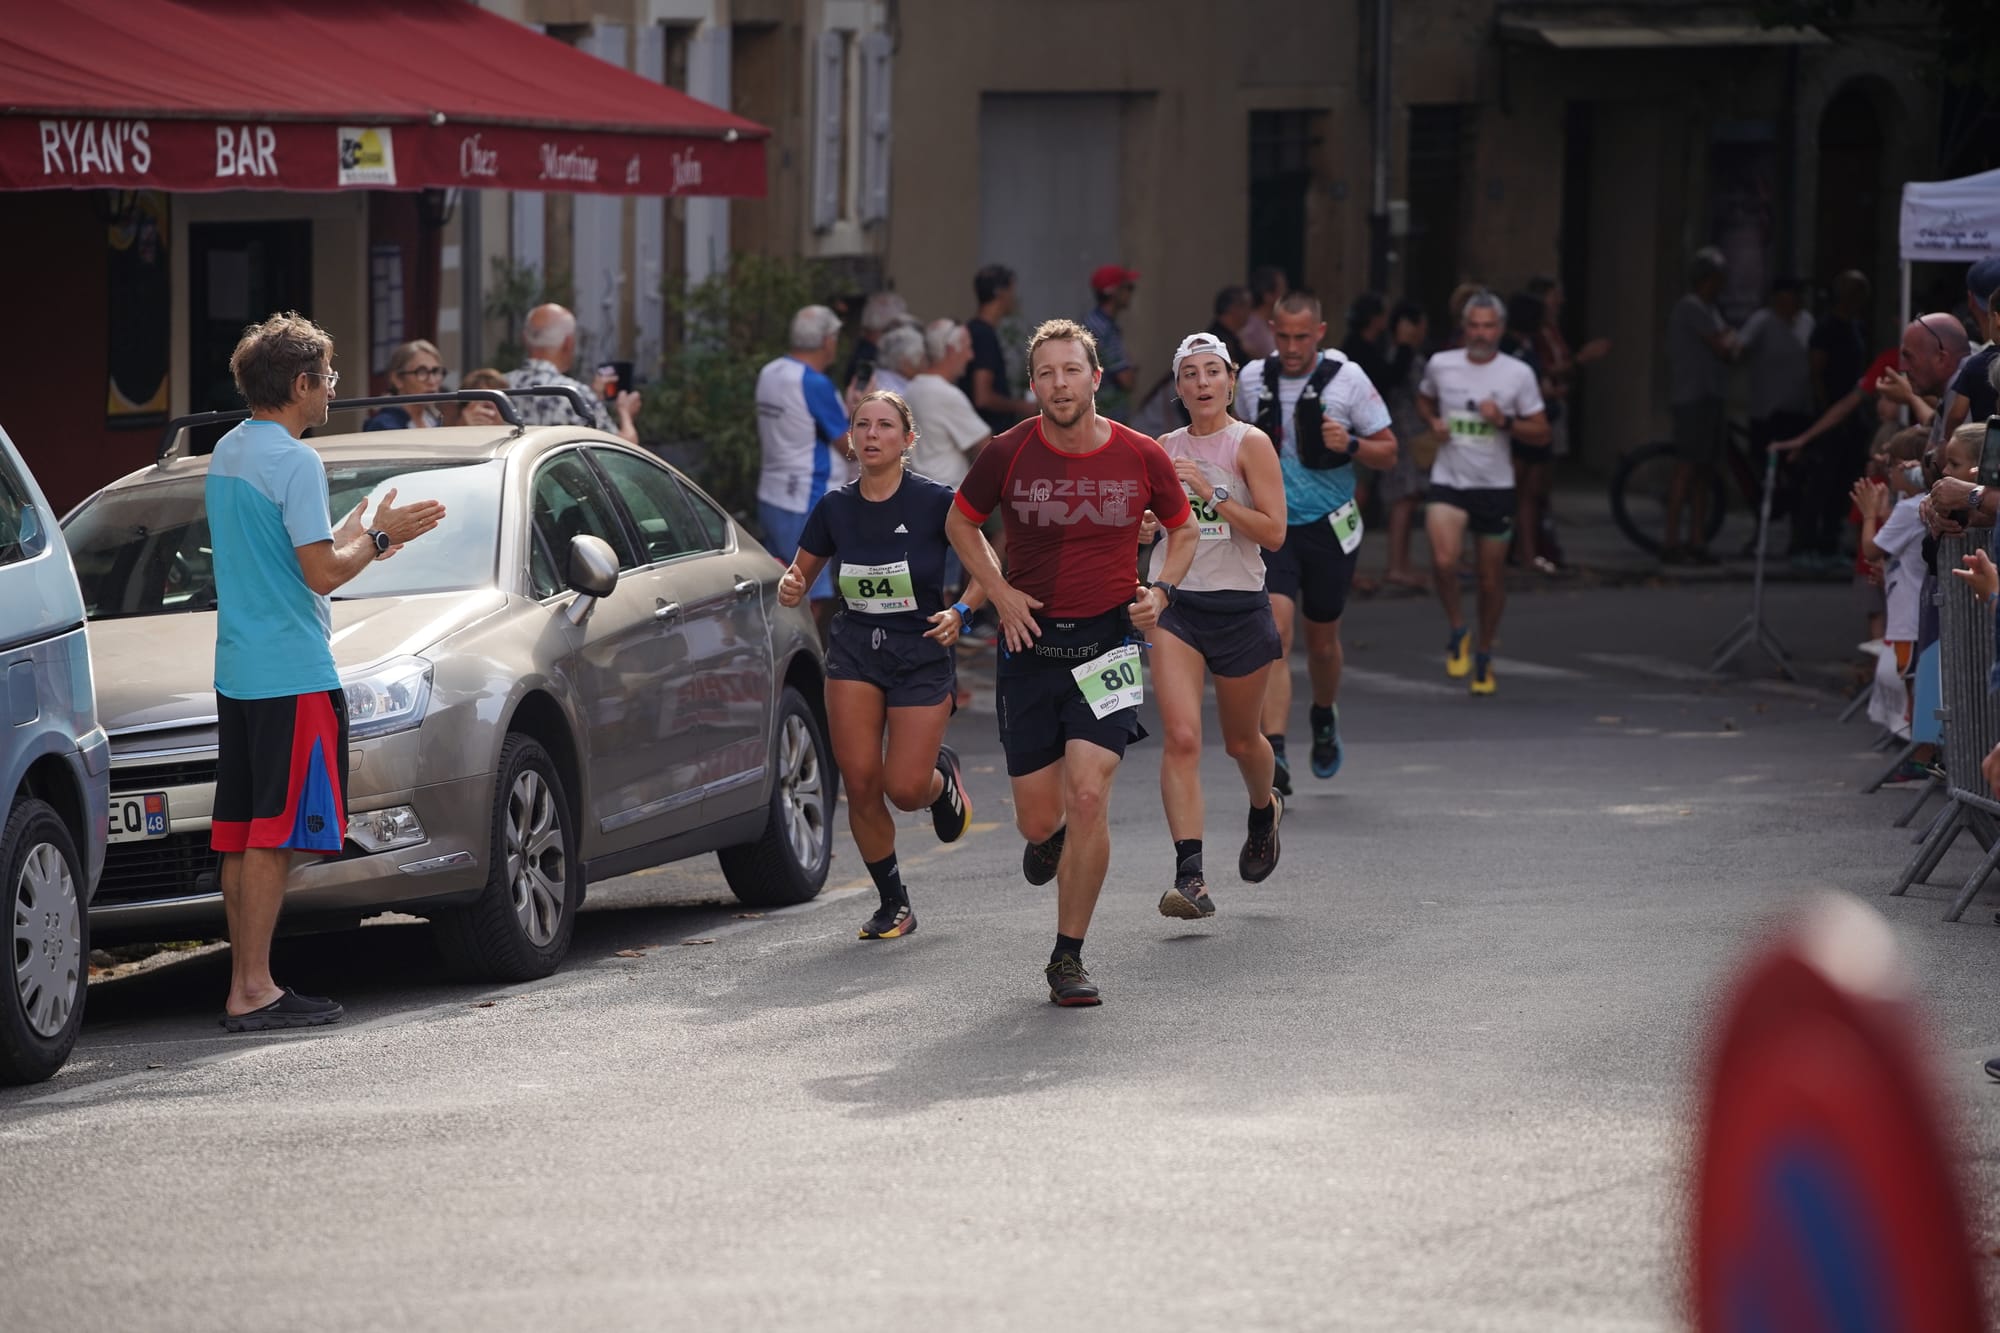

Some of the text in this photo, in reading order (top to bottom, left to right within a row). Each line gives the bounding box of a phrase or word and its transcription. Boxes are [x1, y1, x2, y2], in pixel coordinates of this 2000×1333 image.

[39, 120, 152, 175] RYAN'S
[215, 126, 278, 177] BAR
[459, 133, 702, 193] Chez Martine et John
[1013, 476, 1140, 497] LOZÈRE
[1011, 499, 1138, 527] TRAIL
[858, 578, 894, 598] 84
[1100, 662, 1136, 691] 80
[108, 800, 164, 835] EQ 48
